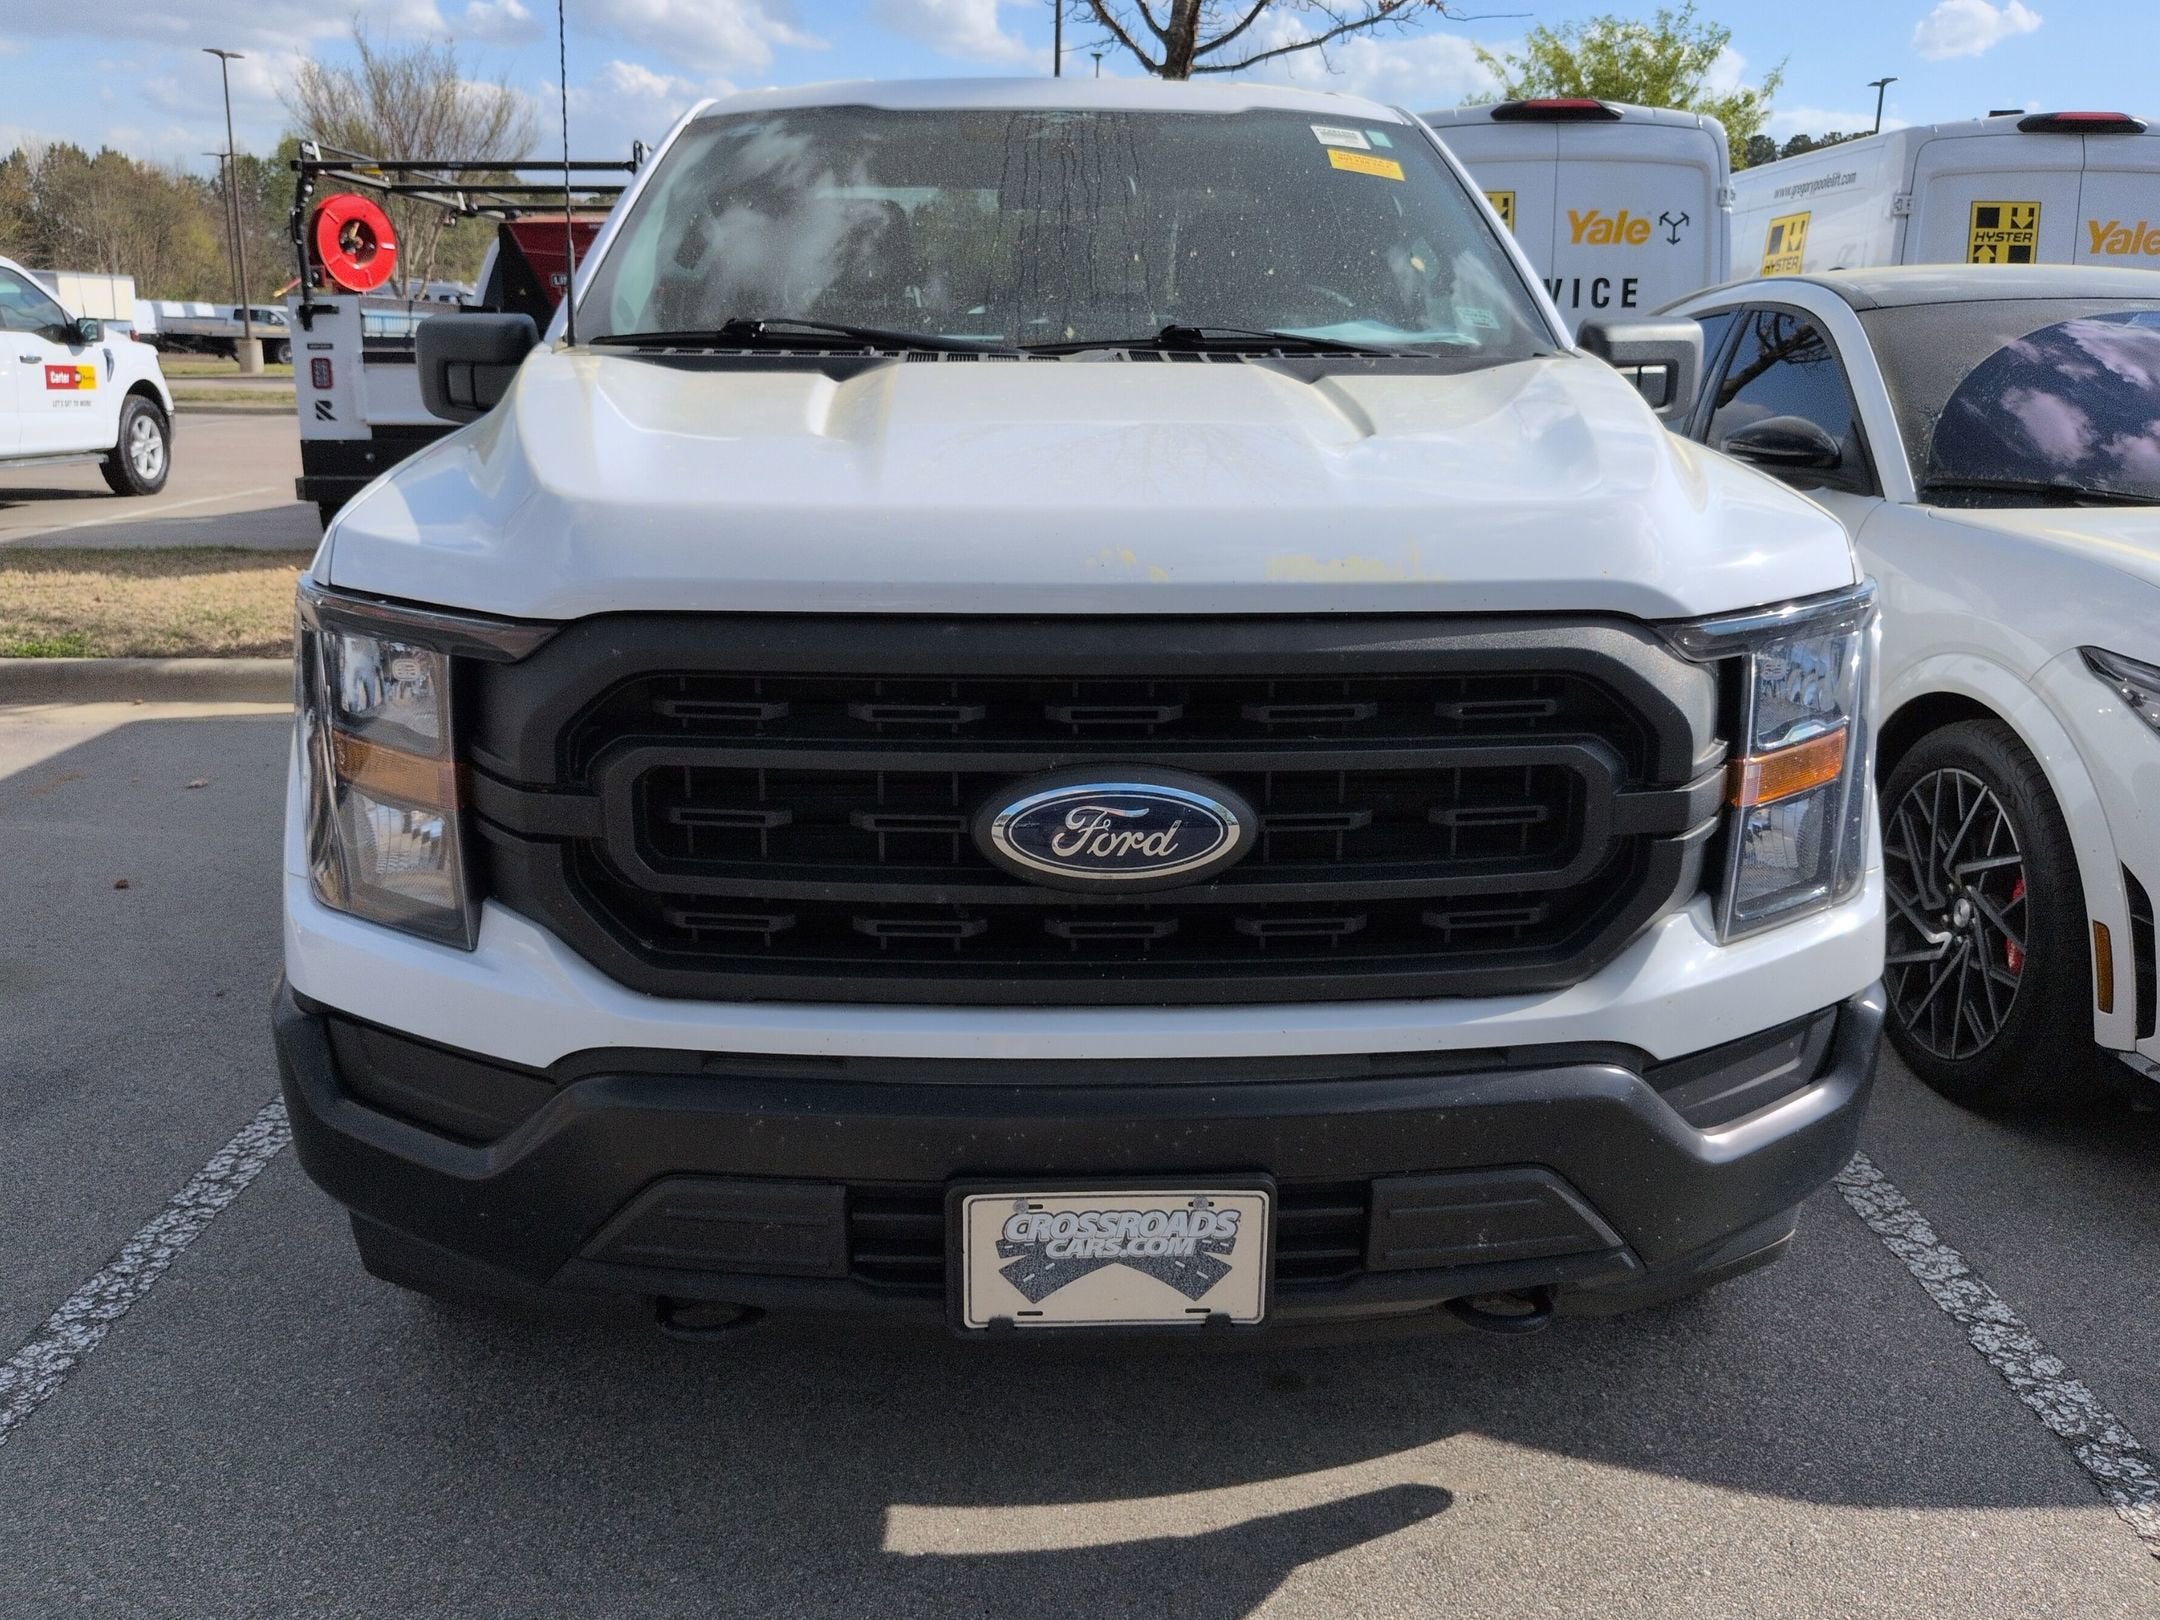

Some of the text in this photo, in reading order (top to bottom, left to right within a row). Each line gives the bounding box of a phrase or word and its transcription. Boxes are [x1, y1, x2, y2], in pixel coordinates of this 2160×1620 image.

[1774, 172, 1857, 199] www.gregorypoolelift.com
[1567, 208, 1652, 245] Yale
[1974, 231, 2033, 243] HYSTER
[50, 370, 70, 384] Carter
[1052, 806, 1179, 857] Ford
[1004, 1209, 1241, 1241] CROSSROADS
[1045, 1236, 1198, 1258] CARS.COM
